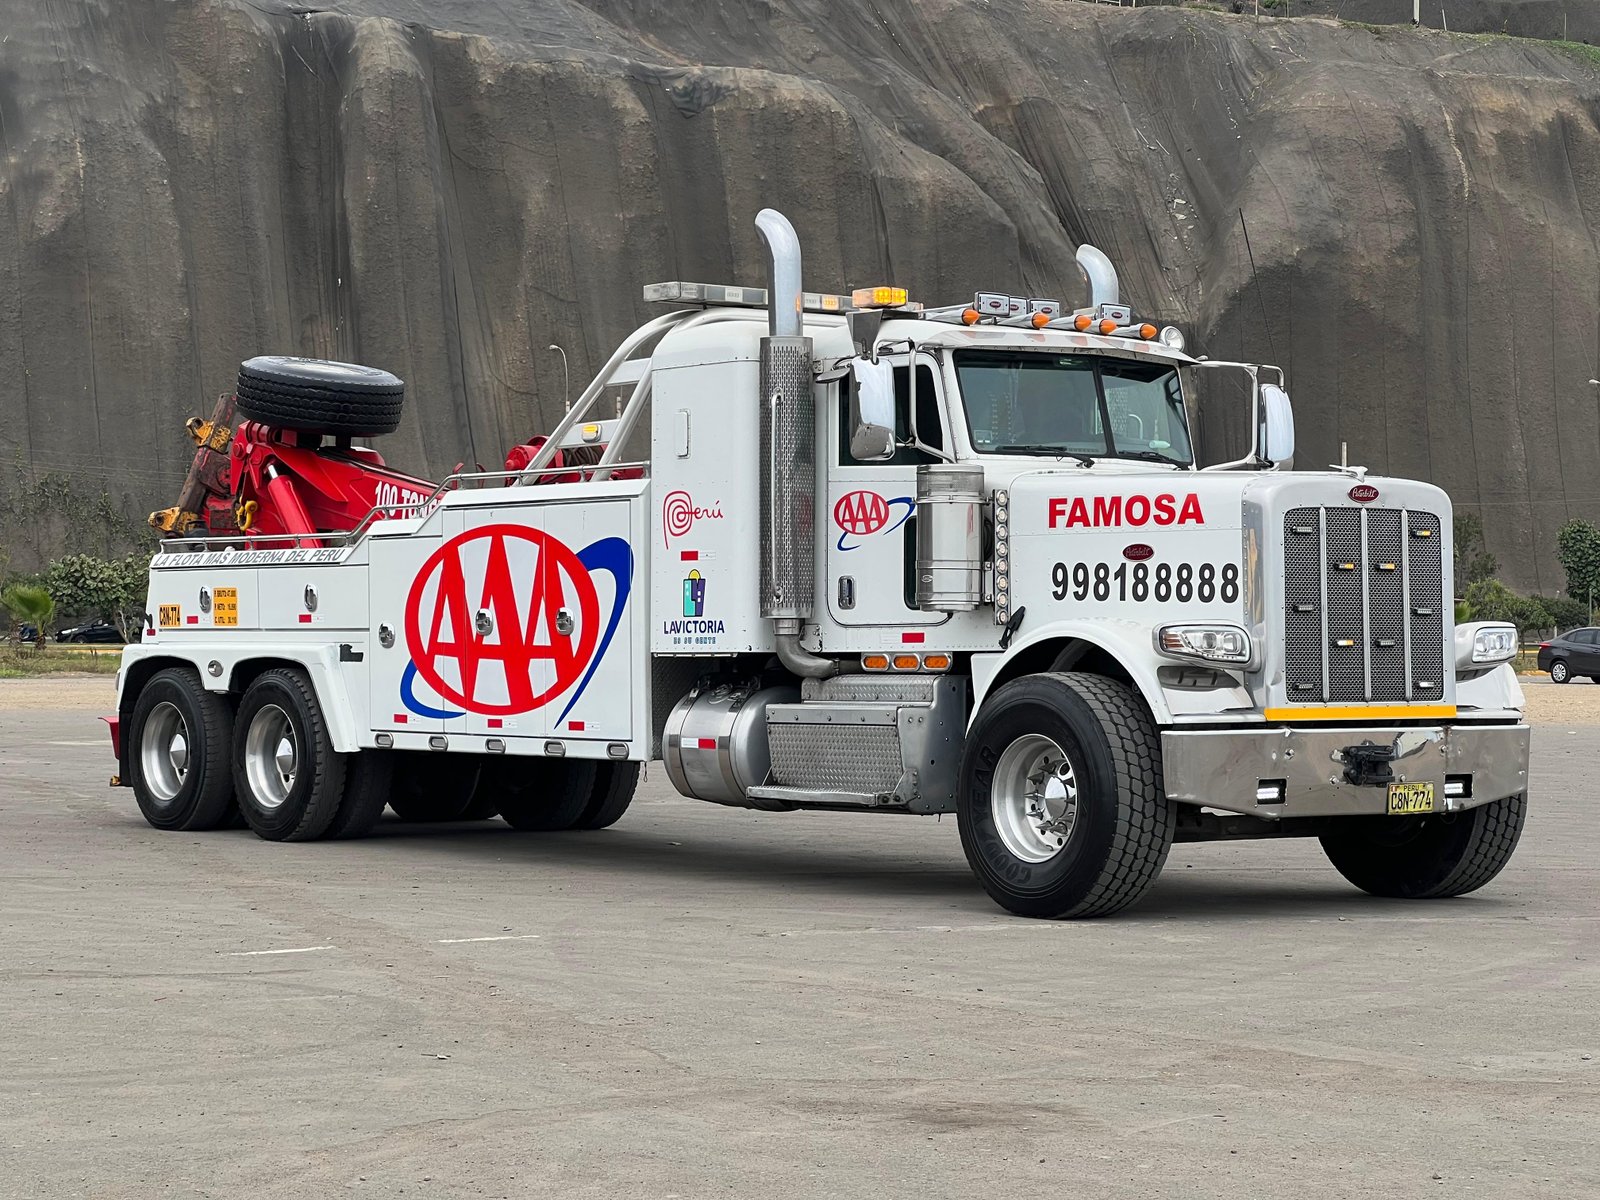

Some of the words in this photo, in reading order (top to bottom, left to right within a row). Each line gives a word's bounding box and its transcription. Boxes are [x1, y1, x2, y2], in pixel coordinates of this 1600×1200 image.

[375, 481, 398, 516] 100
[835, 491, 889, 535] AAA
[1048, 493, 1205, 529] FAMOSA
[153, 555, 171, 566] LA
[169, 554, 205, 565] FLOTA
[203, 552, 231, 565] MAS
[228, 550, 286, 564] MODERNA
[284, 550, 309, 563] DEL
[309, 548, 346, 562] PERU
[1051, 562, 1240, 603] 998188888
[405, 524, 600, 716] AAA
[663, 620, 725, 634] LAVICTORIA
[1391, 791, 1431, 809] C8N-774
